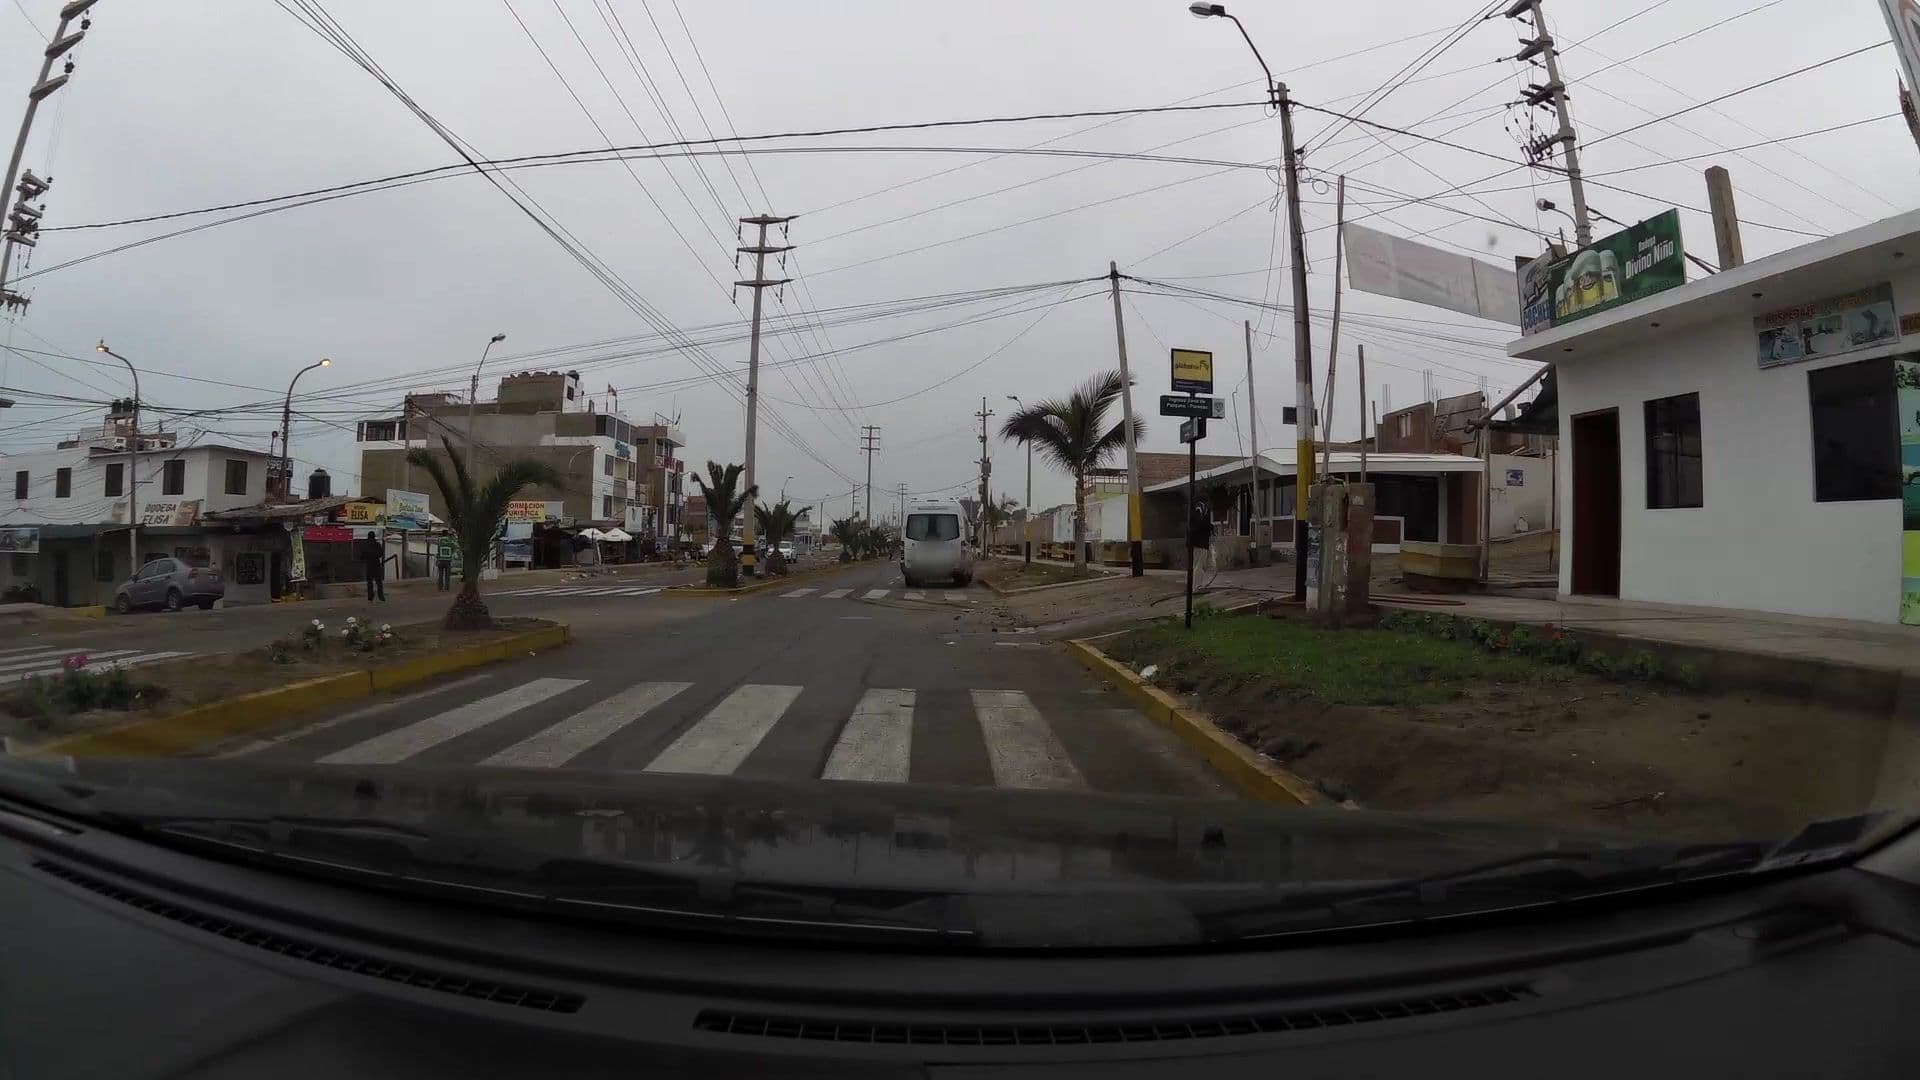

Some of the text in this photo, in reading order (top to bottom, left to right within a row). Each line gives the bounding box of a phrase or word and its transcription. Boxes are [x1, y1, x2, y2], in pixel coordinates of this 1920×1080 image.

[1625, 239, 1674, 279] Divino Niño
[145, 503, 176, 513] BODEGA
[142, 514, 170, 525] ELISA
[351, 511, 368, 520] ELISA
